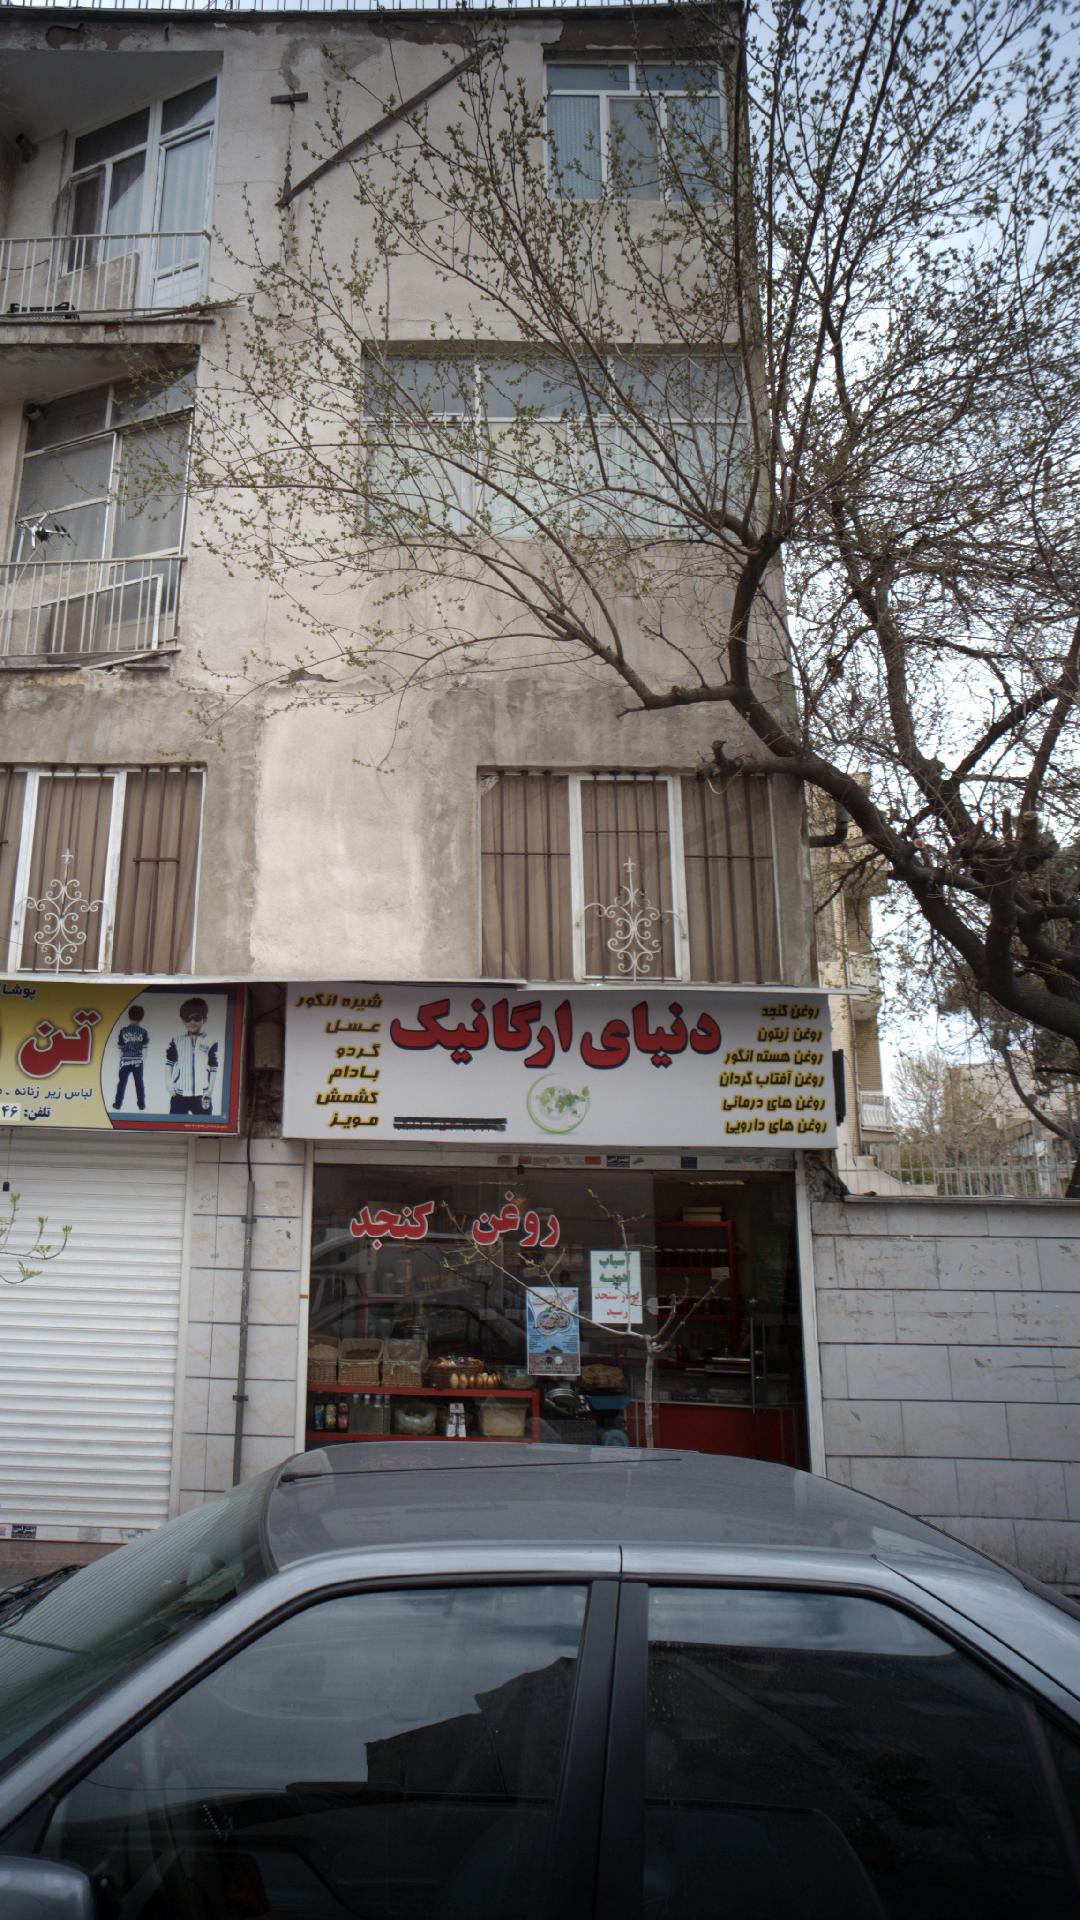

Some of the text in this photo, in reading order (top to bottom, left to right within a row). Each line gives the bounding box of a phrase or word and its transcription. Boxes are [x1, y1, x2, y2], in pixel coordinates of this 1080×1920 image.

[0, 983, 36, 1001] پوشا
[341, 991, 383, 1011] شیره
[761, 1004, 820, 1021] روغن کنجد
[326, 1019, 381, 1034] عسل
[389, 998, 721, 1070] دنیای ارگانیک
[757, 1027, 823, 1043] روغن زیتون
[18, 1010, 101, 1078] تن
[336, 1042, 381, 1059] گردو
[756, 1050, 790, 1063] هسته
[794, 1050, 824, 1065] روغن
[328, 1065, 380, 1085] بادام
[756, 1070, 793, 1088] آفتاب
[794, 1072, 825, 1088] روغن
[15, 1086, 40, 1099] زنانه
[45, 1087, 61, 1100] زیر
[64, 1087, 92, 1100] لباس
[316, 1087, 379, 1106] کشمش
[722, 1095, 826, 1111] روغن های درمانی
[329, 1112, 379, 1130] مویز
[725, 1118, 827, 1135] روغن های دارویی
[350, 1191, 560, 1250] روغن کنجد
